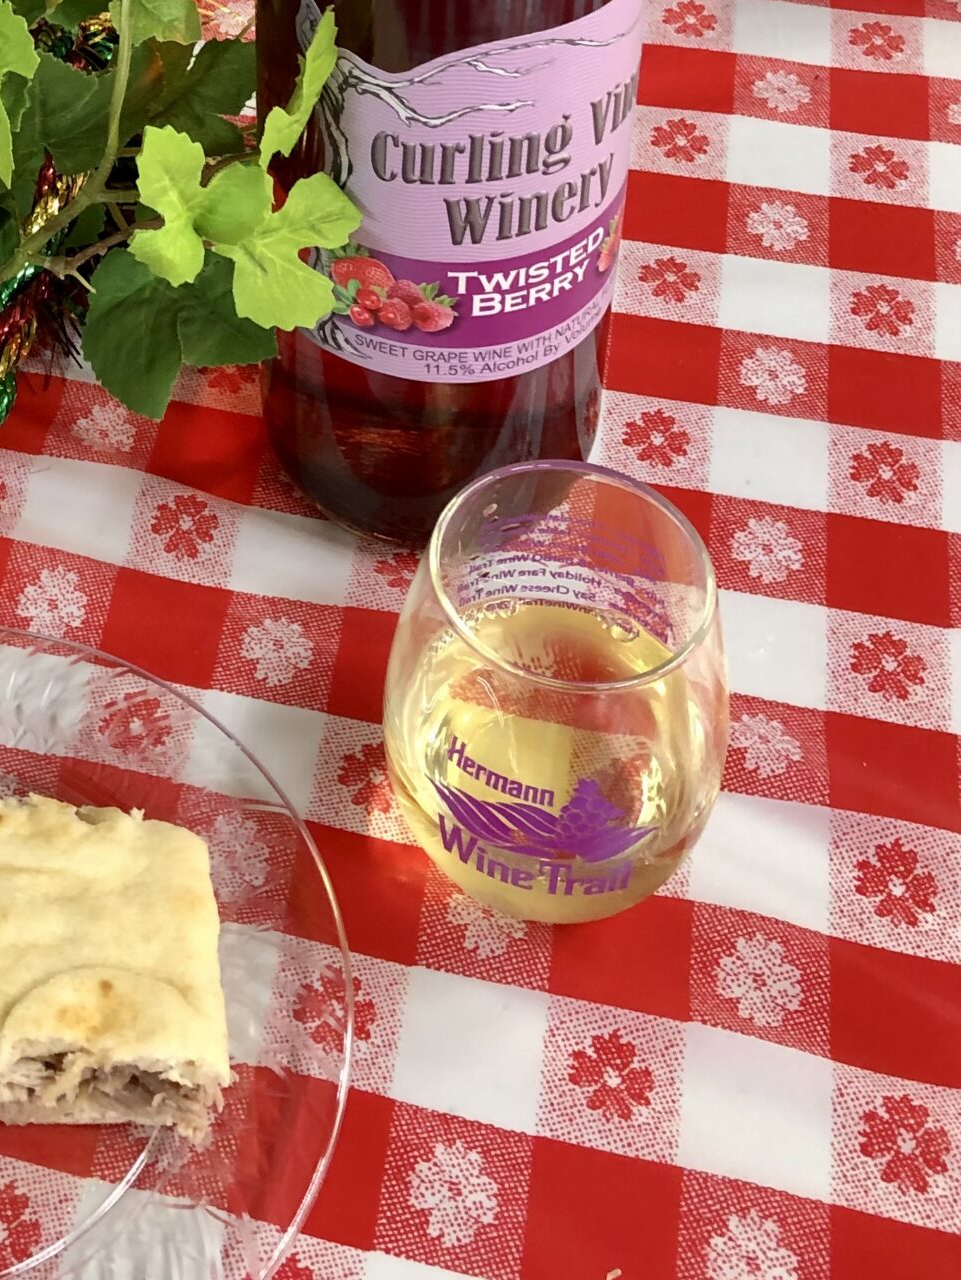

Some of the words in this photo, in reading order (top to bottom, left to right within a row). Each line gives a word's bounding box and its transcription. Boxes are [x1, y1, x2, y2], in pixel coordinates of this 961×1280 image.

[370, 113, 573, 186] Curling
[443, 153, 614, 246] Winery
[447, 226, 605, 296] TWISTED
[471, 259, 590, 317] BERRY
[354, 333, 409, 358] SWEET
[413, 349, 469, 365] GRAPE
[473, 346, 513, 363] WINE
[516, 333, 552, 359] WITH
[424, 363, 476, 376] 11.5%
[480, 350, 539, 375] Alcohol
[543, 341, 562, 359] By
[447, 735, 554, 807] Hermann
[438, 812, 533, 891] Wine
[538, 859, 634, 896] Trail
